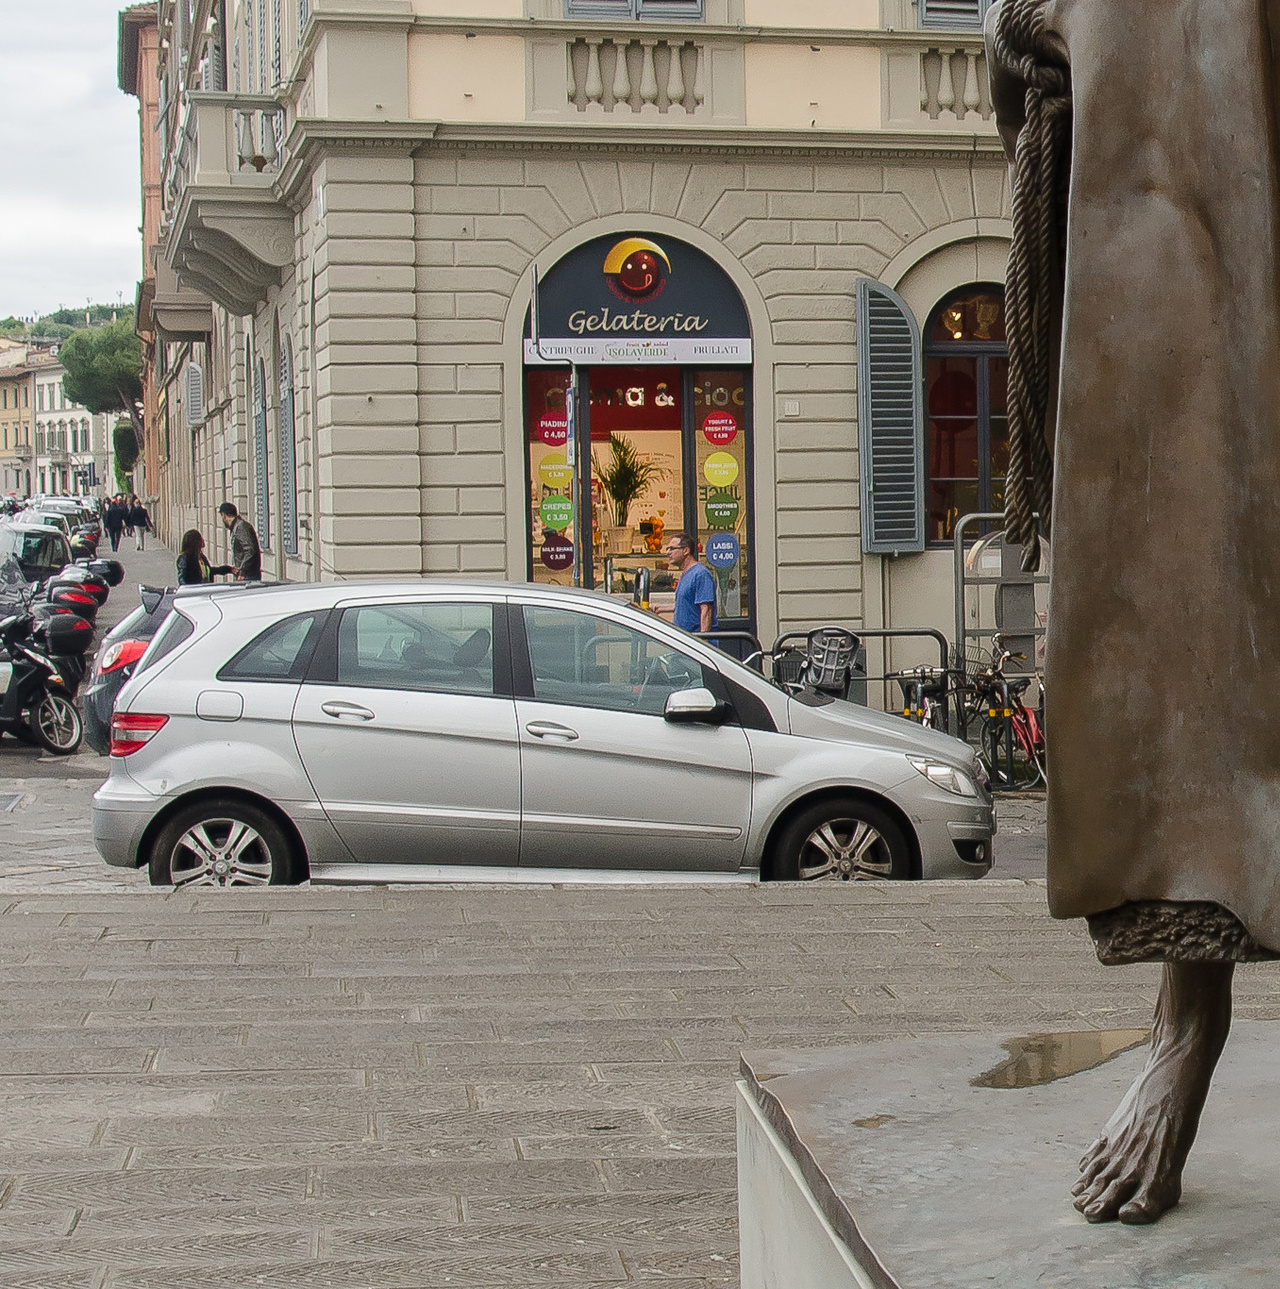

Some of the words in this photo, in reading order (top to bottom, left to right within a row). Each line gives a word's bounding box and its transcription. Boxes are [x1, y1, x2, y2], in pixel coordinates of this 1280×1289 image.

[568, 307, 708, 334] Gelateria
[528, 346, 598, 355] CNTRIFUGHE
[693, 345, 739, 354] FRULLATI
[542, 502, 572, 510] CREPES
